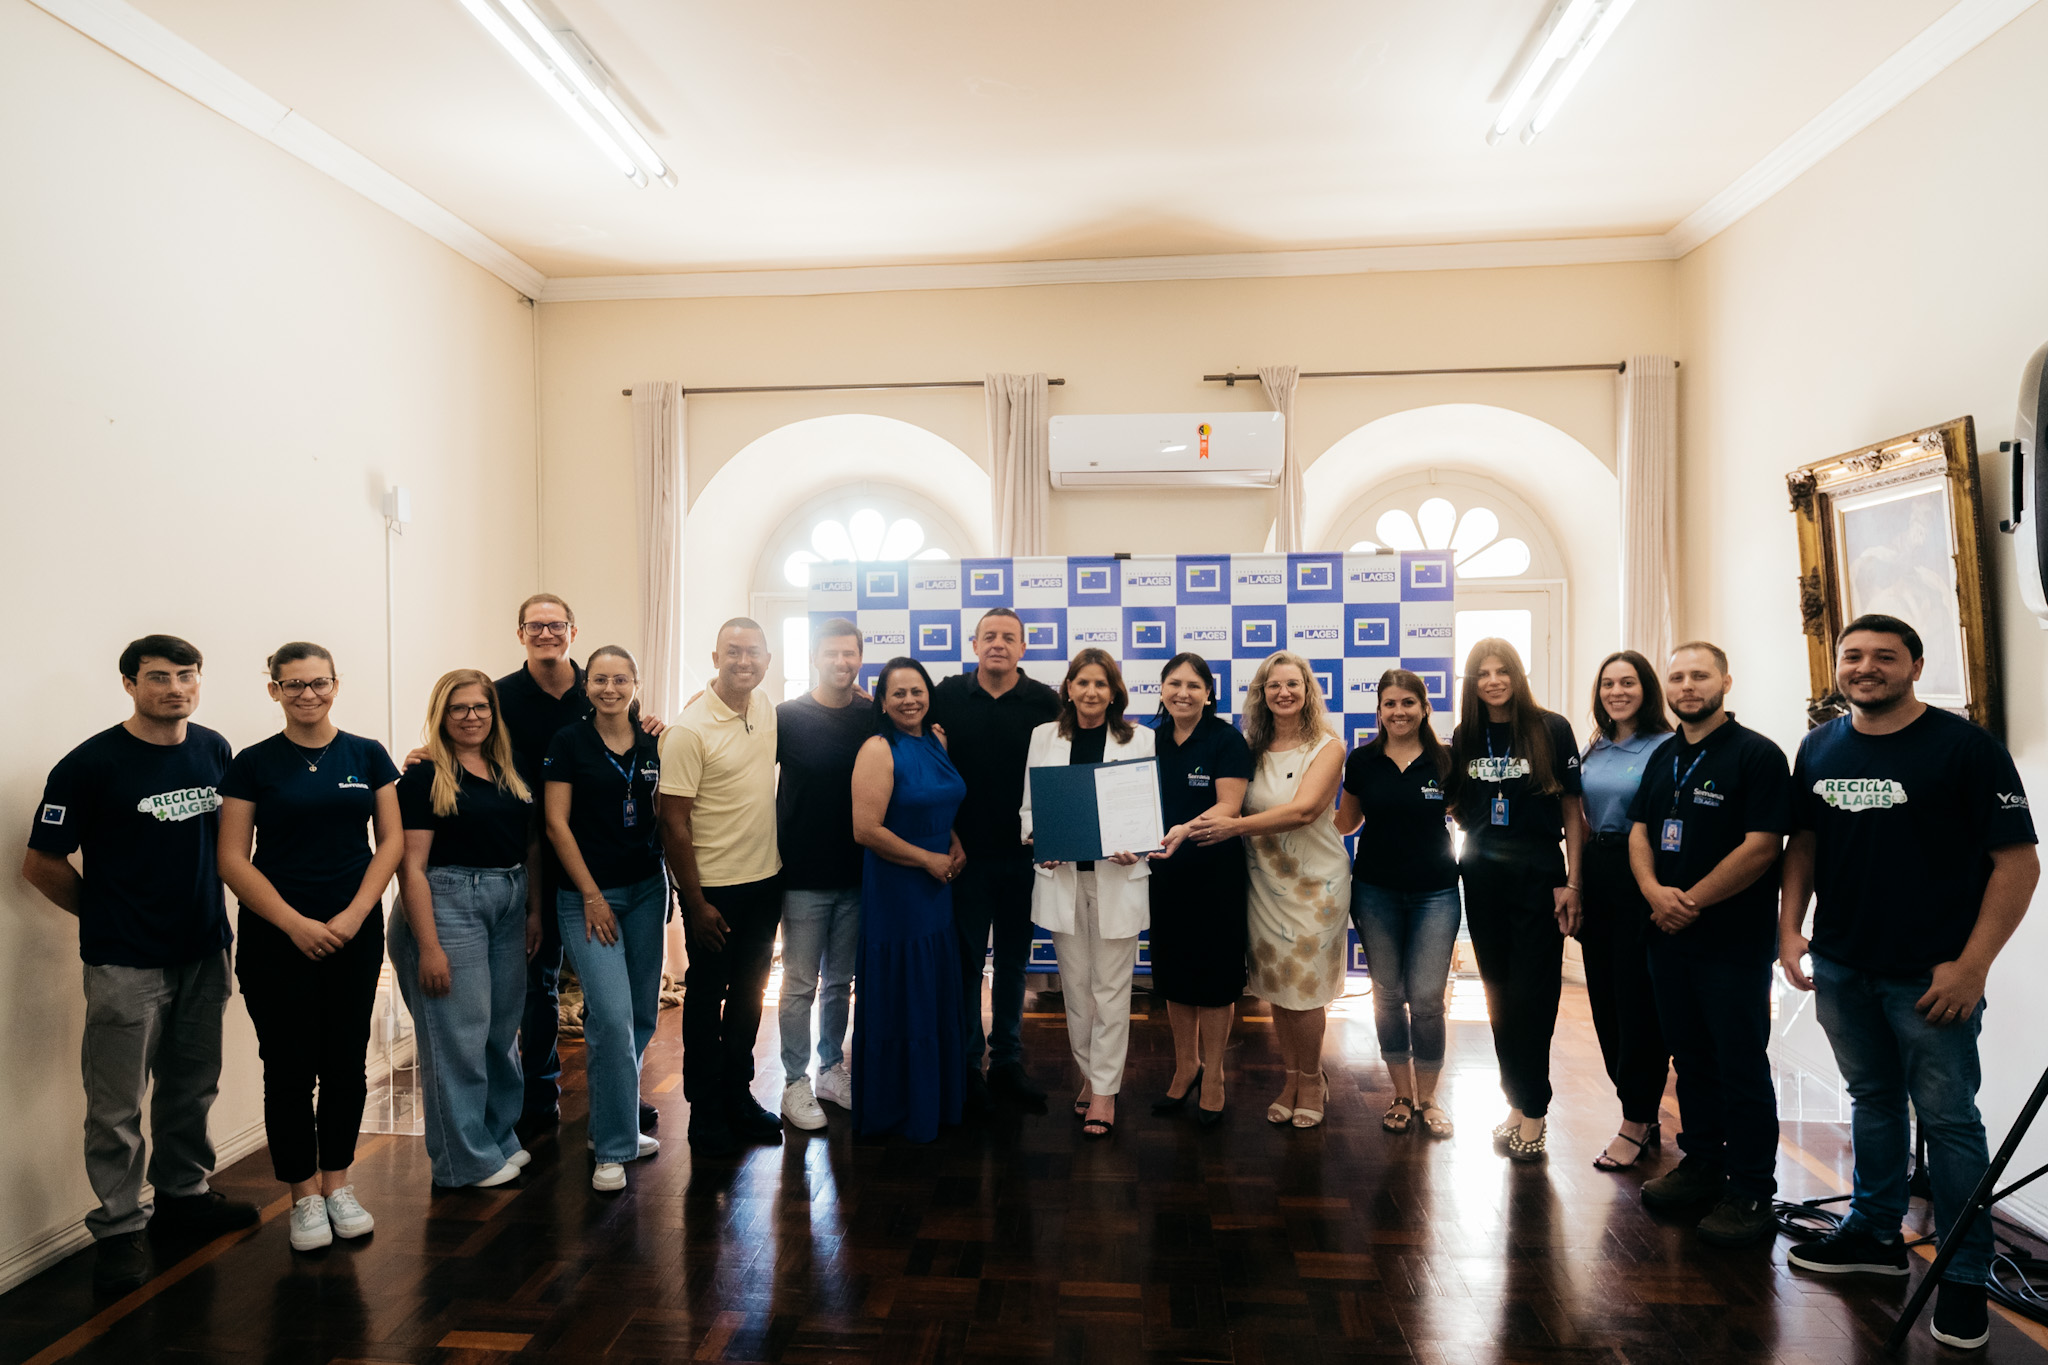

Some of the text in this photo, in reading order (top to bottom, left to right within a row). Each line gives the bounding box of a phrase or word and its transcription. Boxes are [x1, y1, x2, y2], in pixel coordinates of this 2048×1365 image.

[1249, 575, 1281, 584] LAGES
[1362, 572, 1394, 581] LAGES
[925, 580, 956, 589] LAGES
[1031, 579, 1062, 588] LAGES
[1139, 577, 1170, 586] LAGES
[1086, 632, 1117, 641] LAGES
[1194, 631, 1226, 640] LAGES
[1306, 630, 1338, 639] LAGES
[1419, 628, 1452, 638] LAGES
[875, 635, 904, 644] LAGES
[1825, 781, 1893, 792] RECICLA
[152, 788, 215, 807] RECICLA
[1842, 794, 1892, 806] LAGES
[170, 799, 216, 817] LAGES
